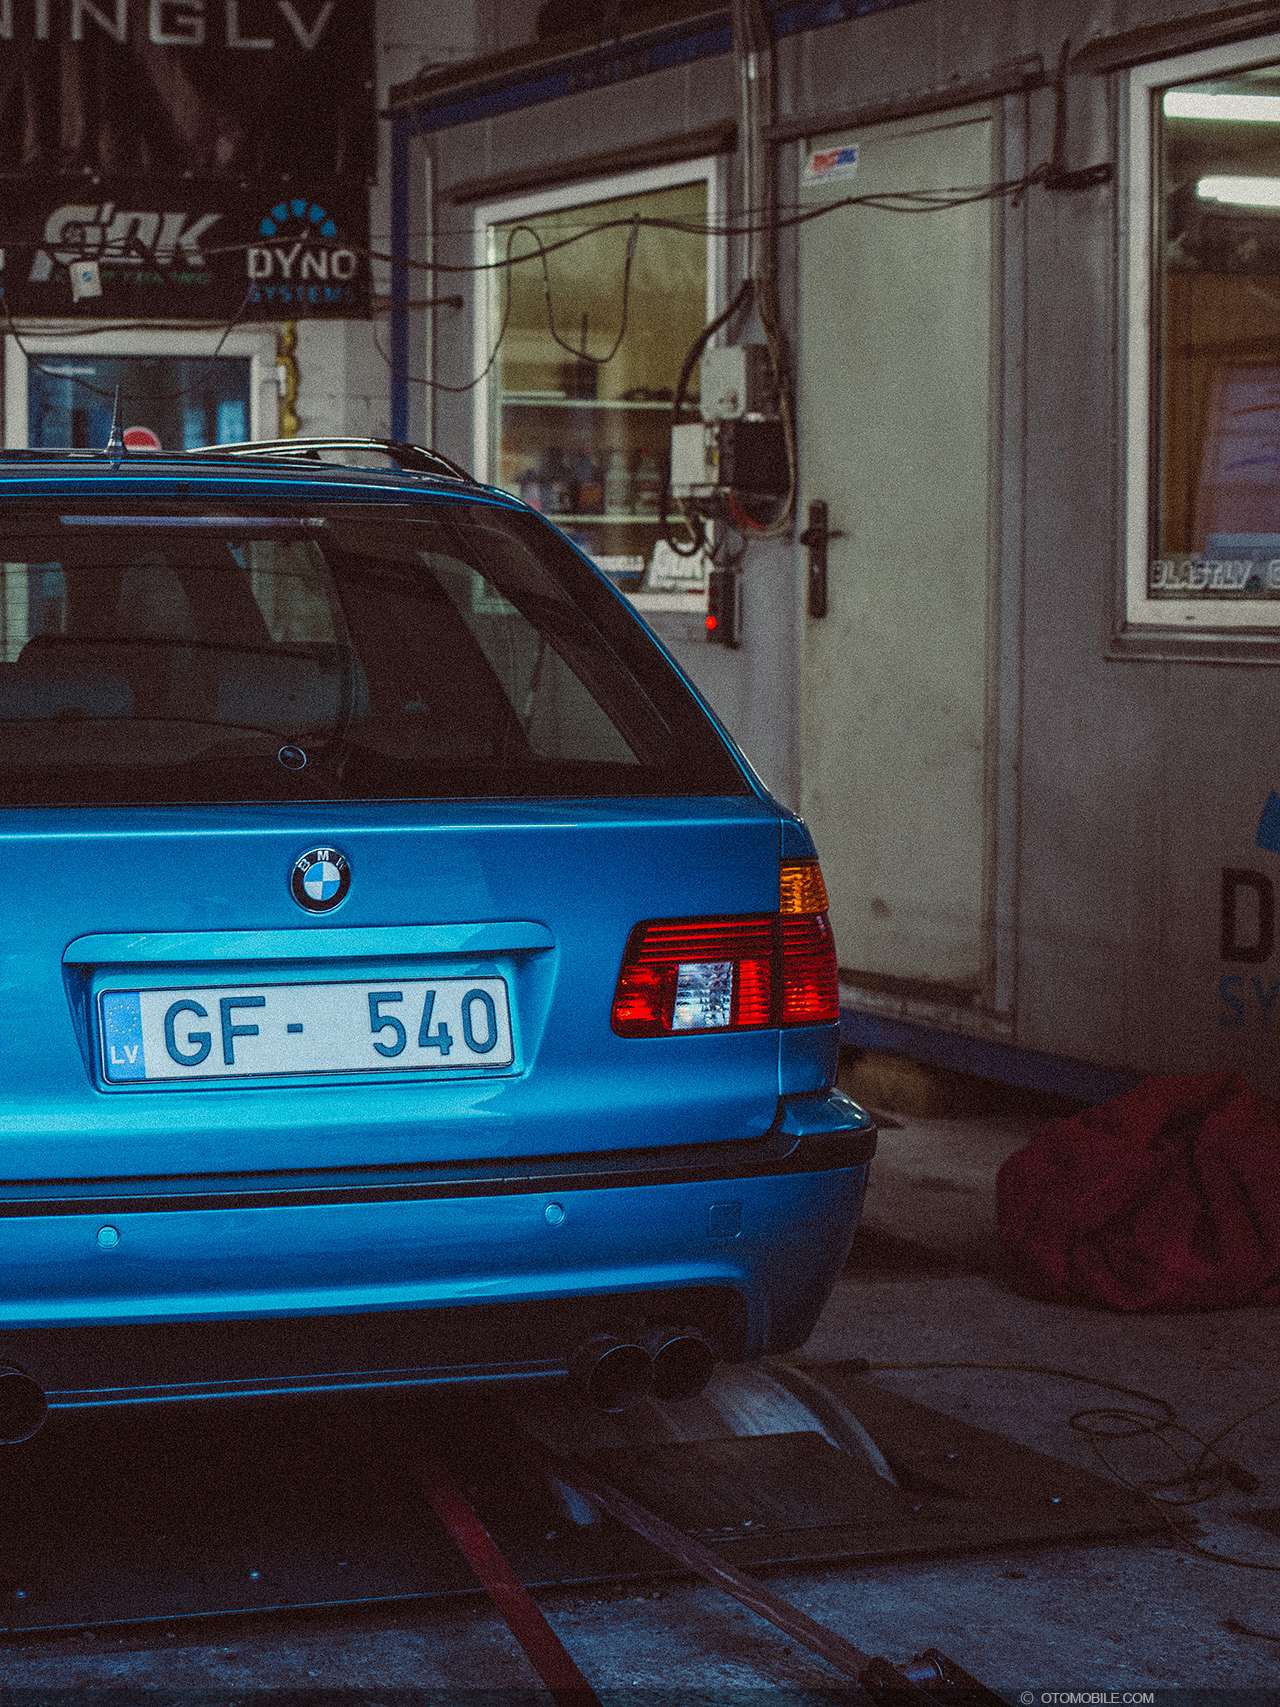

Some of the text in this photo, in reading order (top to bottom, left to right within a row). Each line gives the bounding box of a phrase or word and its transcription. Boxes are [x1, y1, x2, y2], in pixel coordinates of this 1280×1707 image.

[247, 243, 357, 280] DYNO
[248, 285, 355, 304] SYSTEMS
[297, 850, 347, 872] BMW
[368, 989, 498, 1058] 540
[110, 1045, 139, 1065] LV
